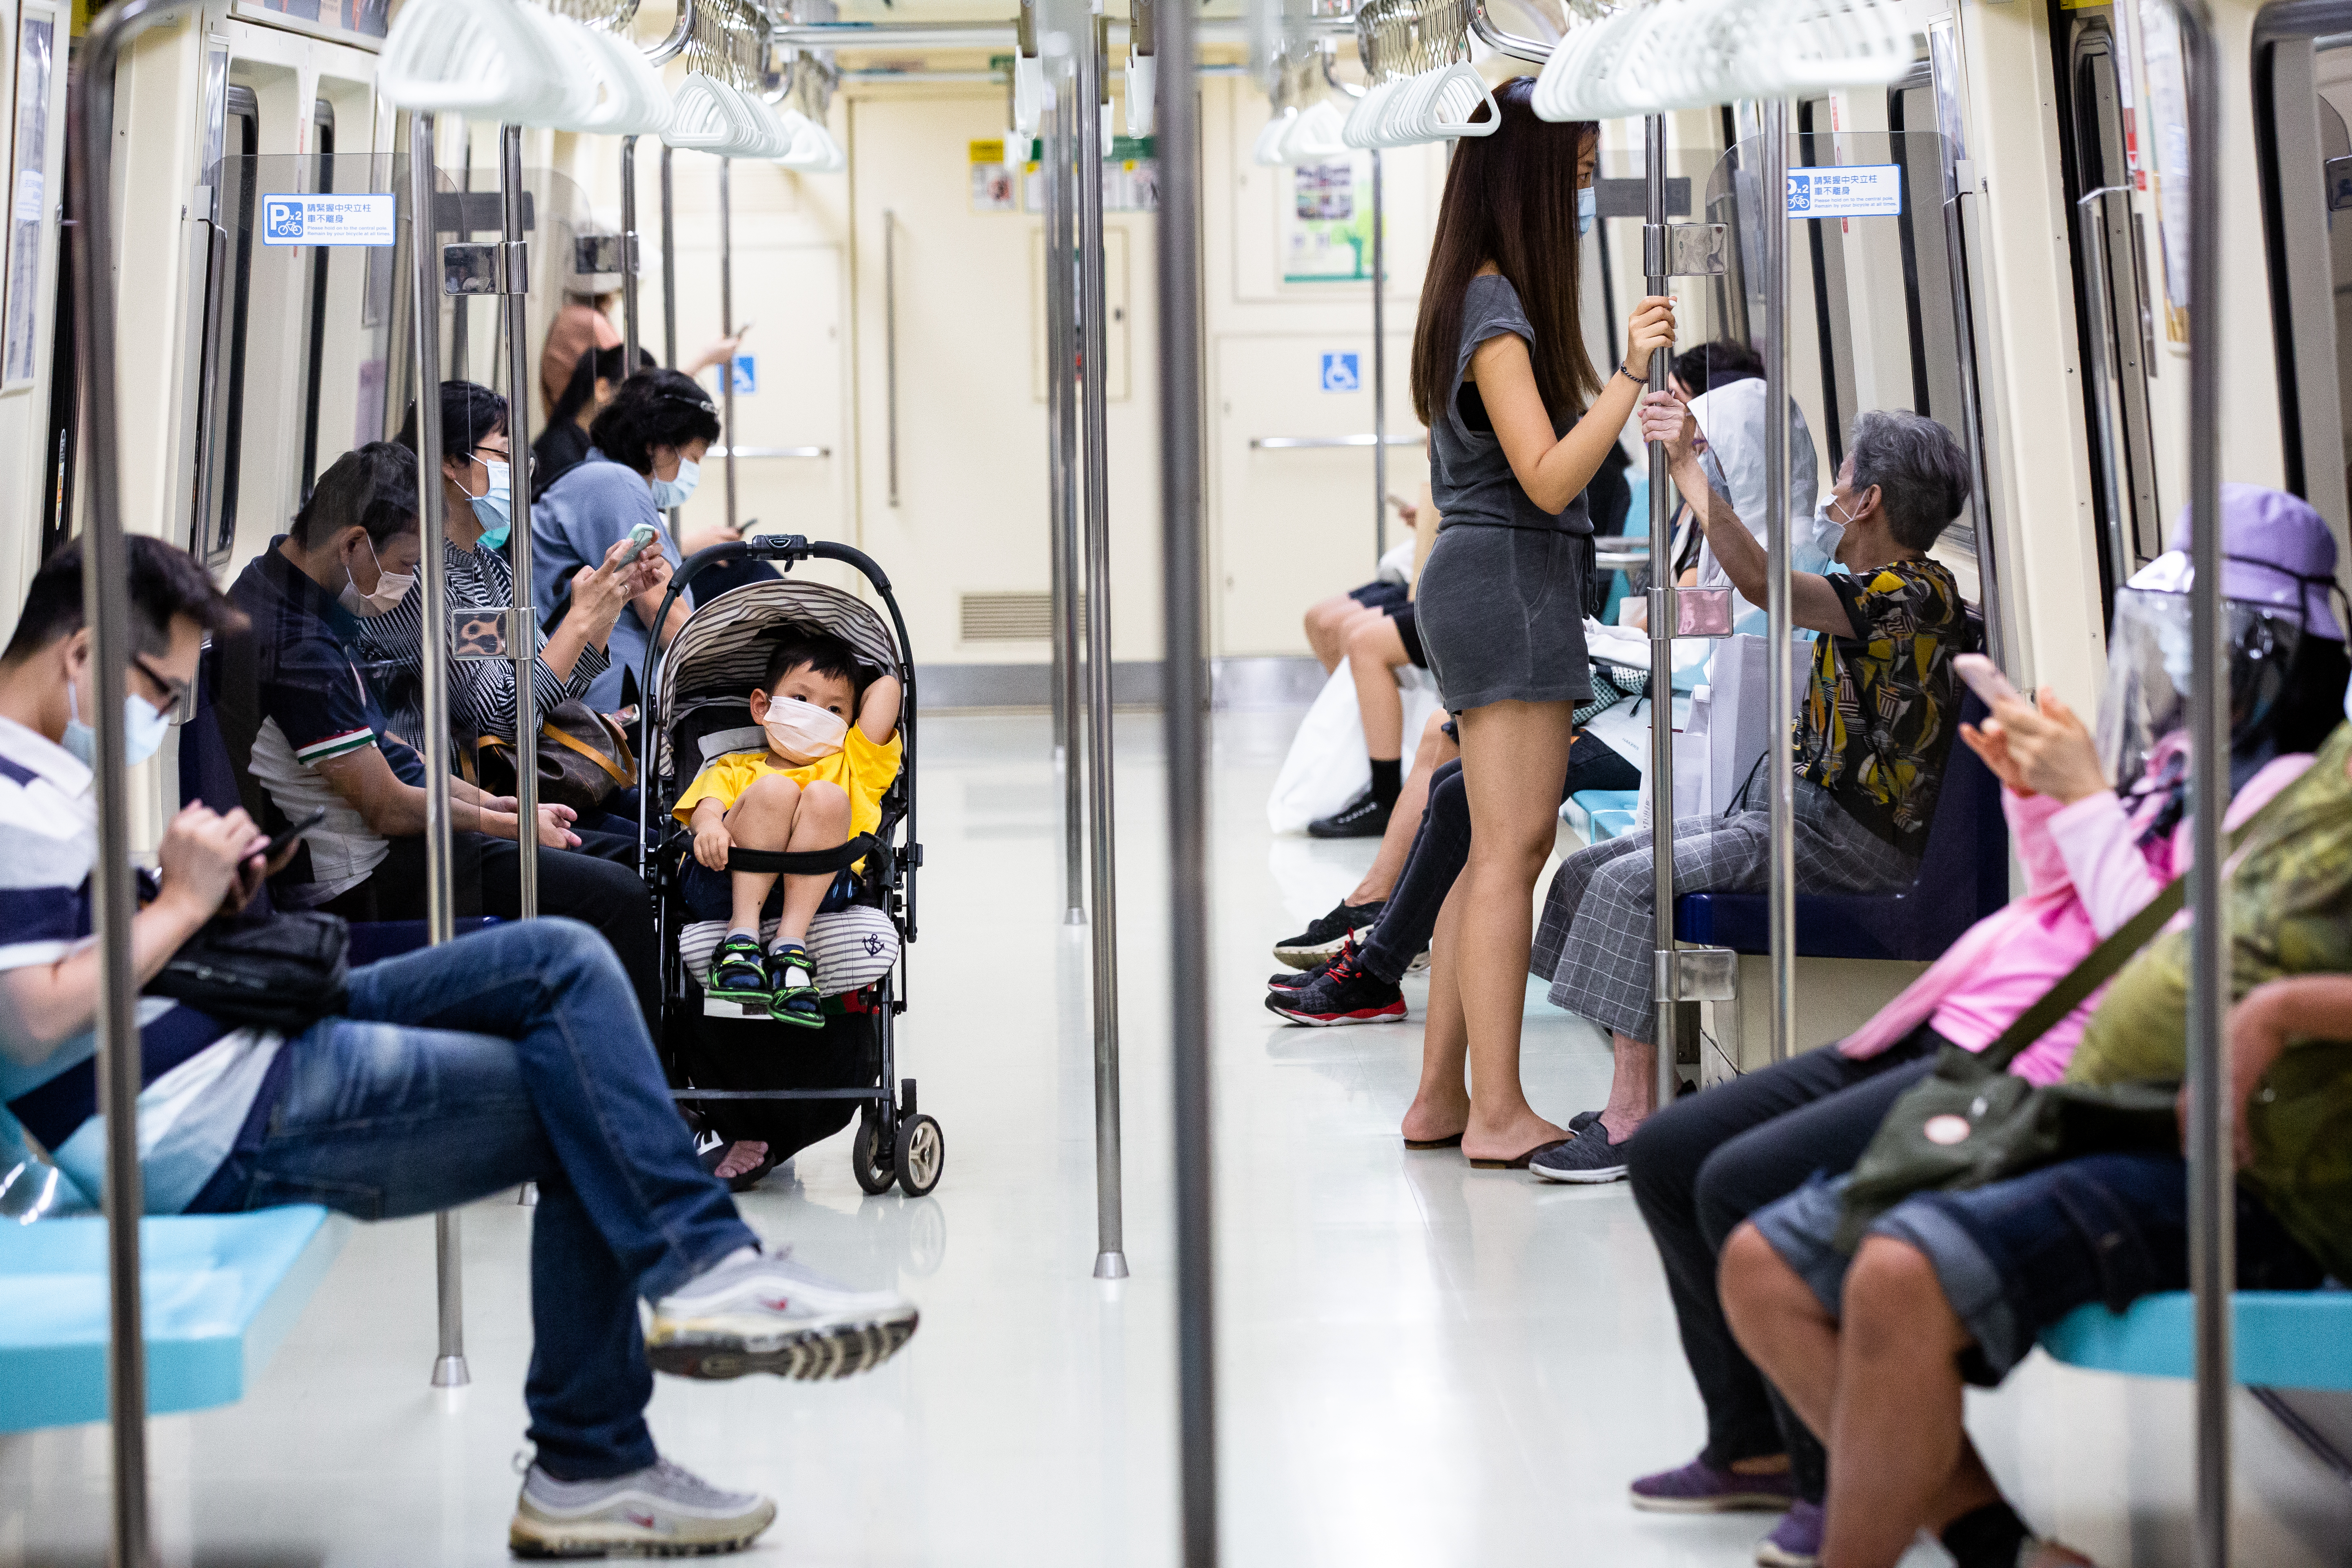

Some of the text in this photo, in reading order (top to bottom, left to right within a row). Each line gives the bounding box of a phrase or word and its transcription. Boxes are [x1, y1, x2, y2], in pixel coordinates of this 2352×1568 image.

[1814, 175, 1878, 185] 請緊握中央立柱
[1814, 186, 1850, 195] 車不離身
[307, 203, 371, 212] 請緊握中央立柱
[270, 205, 290, 230] P
[307, 214, 344, 223] 車不離身
